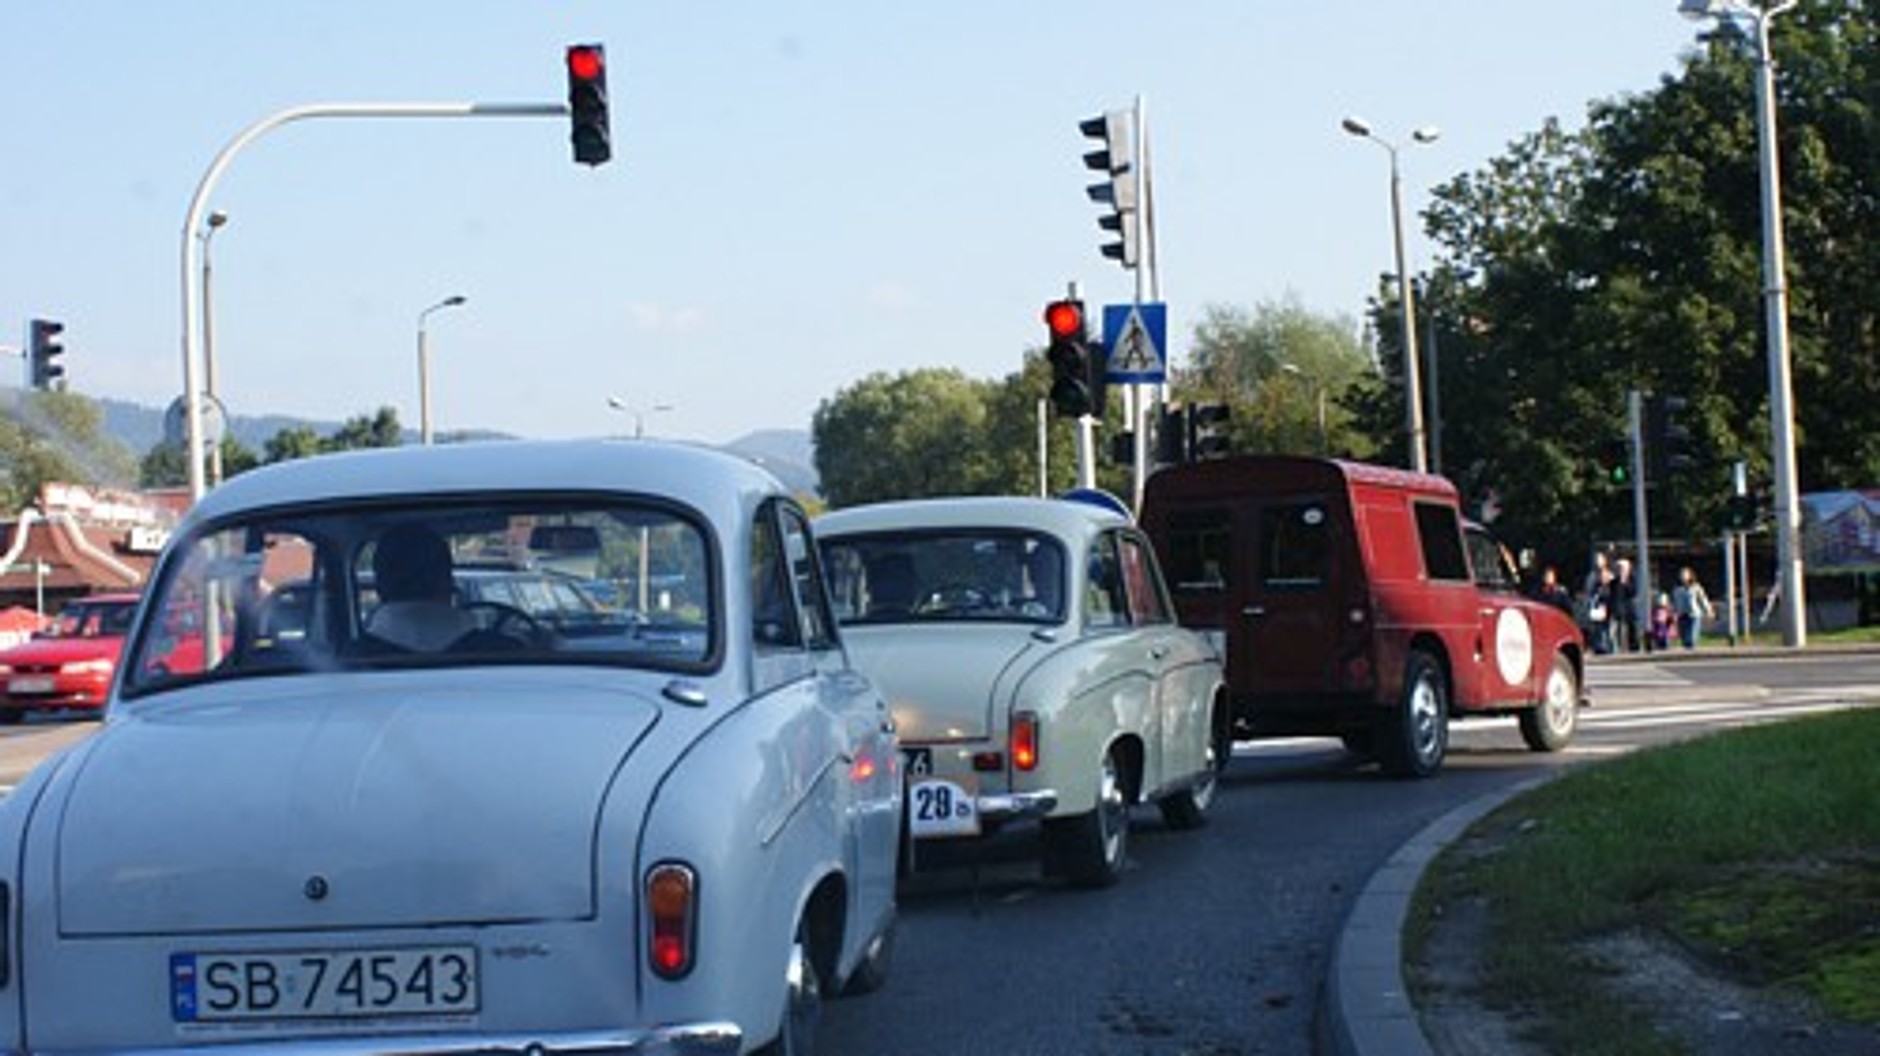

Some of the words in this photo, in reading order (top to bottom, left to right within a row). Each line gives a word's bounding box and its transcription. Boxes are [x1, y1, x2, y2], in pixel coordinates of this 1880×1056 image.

[916, 785, 952, 820] 29
[206, 961, 281, 1011] SB
[301, 954, 469, 1009] 74543
